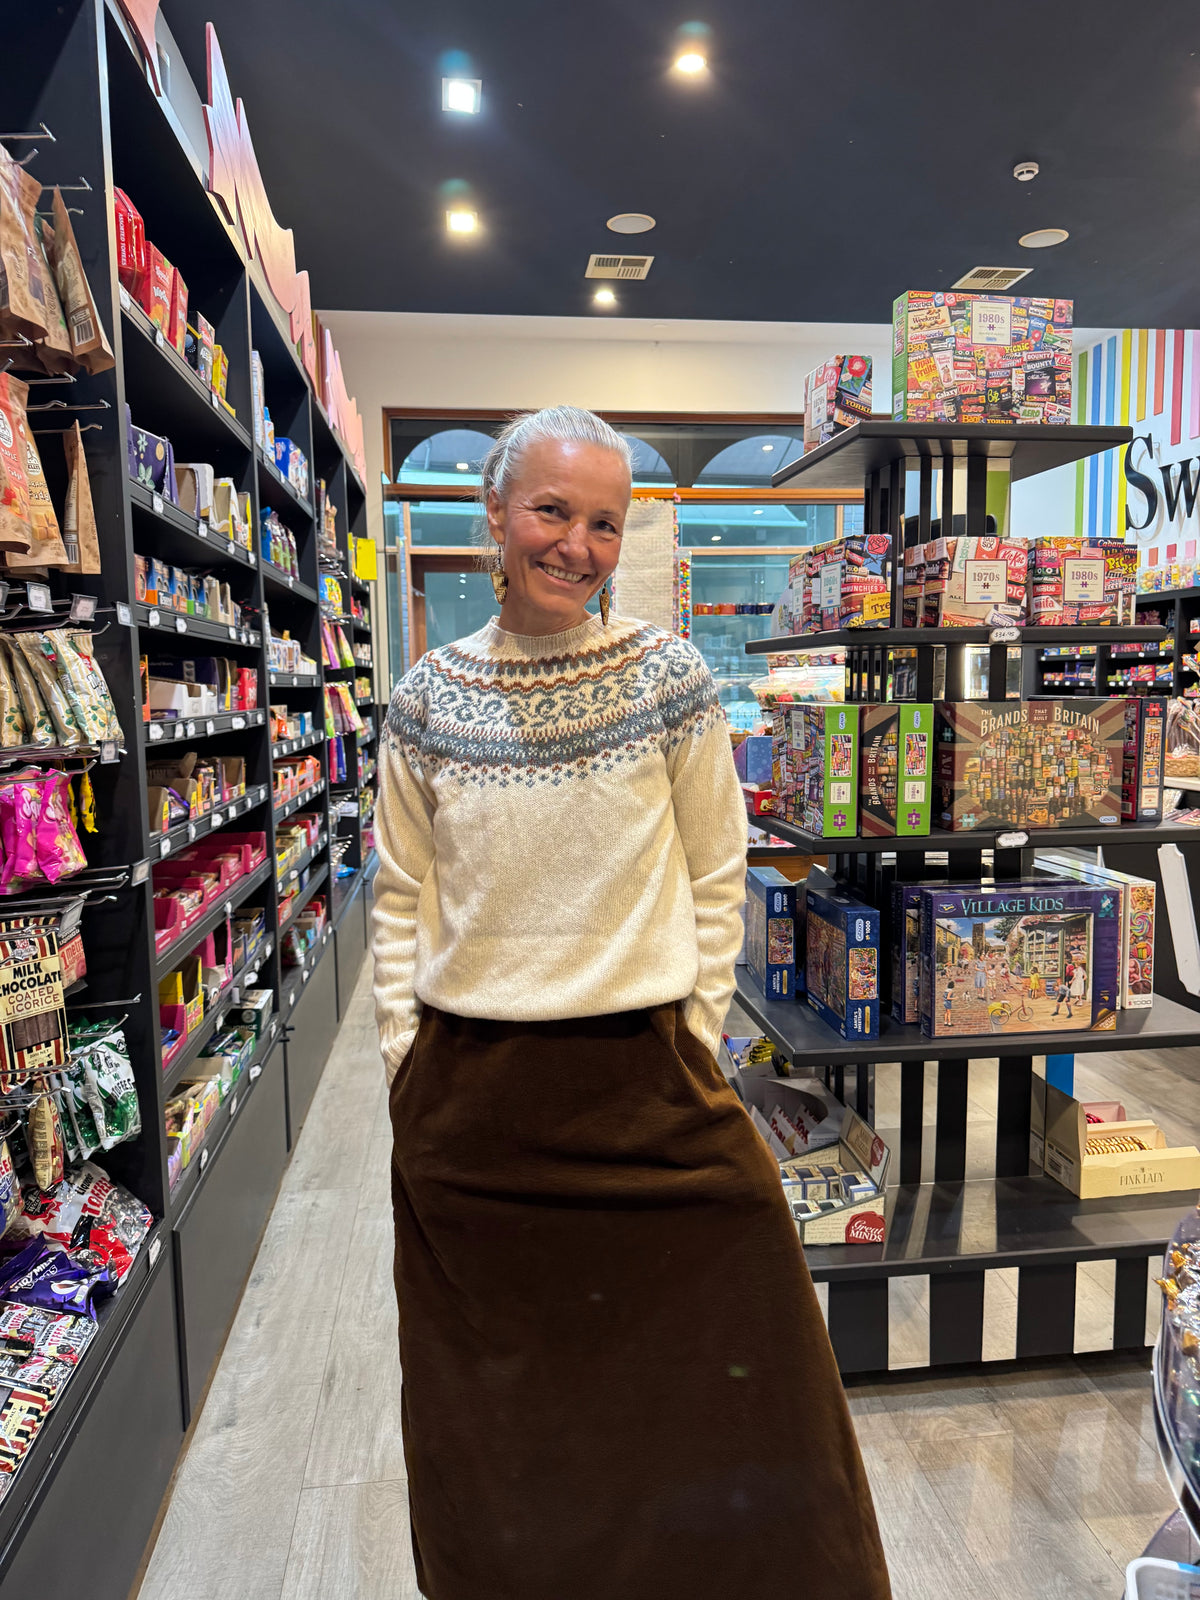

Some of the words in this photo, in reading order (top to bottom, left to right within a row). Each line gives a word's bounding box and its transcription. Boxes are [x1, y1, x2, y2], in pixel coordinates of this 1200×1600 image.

[118, 213, 126, 242] ASSORTED
[978, 313, 1005, 324] 1980s
[1026, 352, 1051, 360] BOUNTY
[915, 364, 938, 378] Fruits
[1026, 360, 1053, 370] BOUNTY
[935, 388, 958, 400] Galaxy
[1021, 408, 1040, 418] AERO
[972, 572, 1000, 582] 1970s
[1071, 571, 1098, 581] 1980s
[980, 709, 1028, 737] BRANDS
[1054, 707, 1099, 735] BRITAIN
[868, 735, 883, 763] BRITAIN
[868, 777, 881, 805] BRANDS
[961, 898, 1026, 916] VILLAGE
[1029, 896, 1064, 913] KIDS
[13, 961, 43, 979] MILK
[8, 985, 54, 1005] COATED
[5, 993, 60, 1016] LICORICE
[1119, 1174, 1141, 1186] PINK
[1143, 1172, 1165, 1185] LADY
[852, 1220, 884, 1235] Great
[849, 1229, 883, 1243] MINDS
